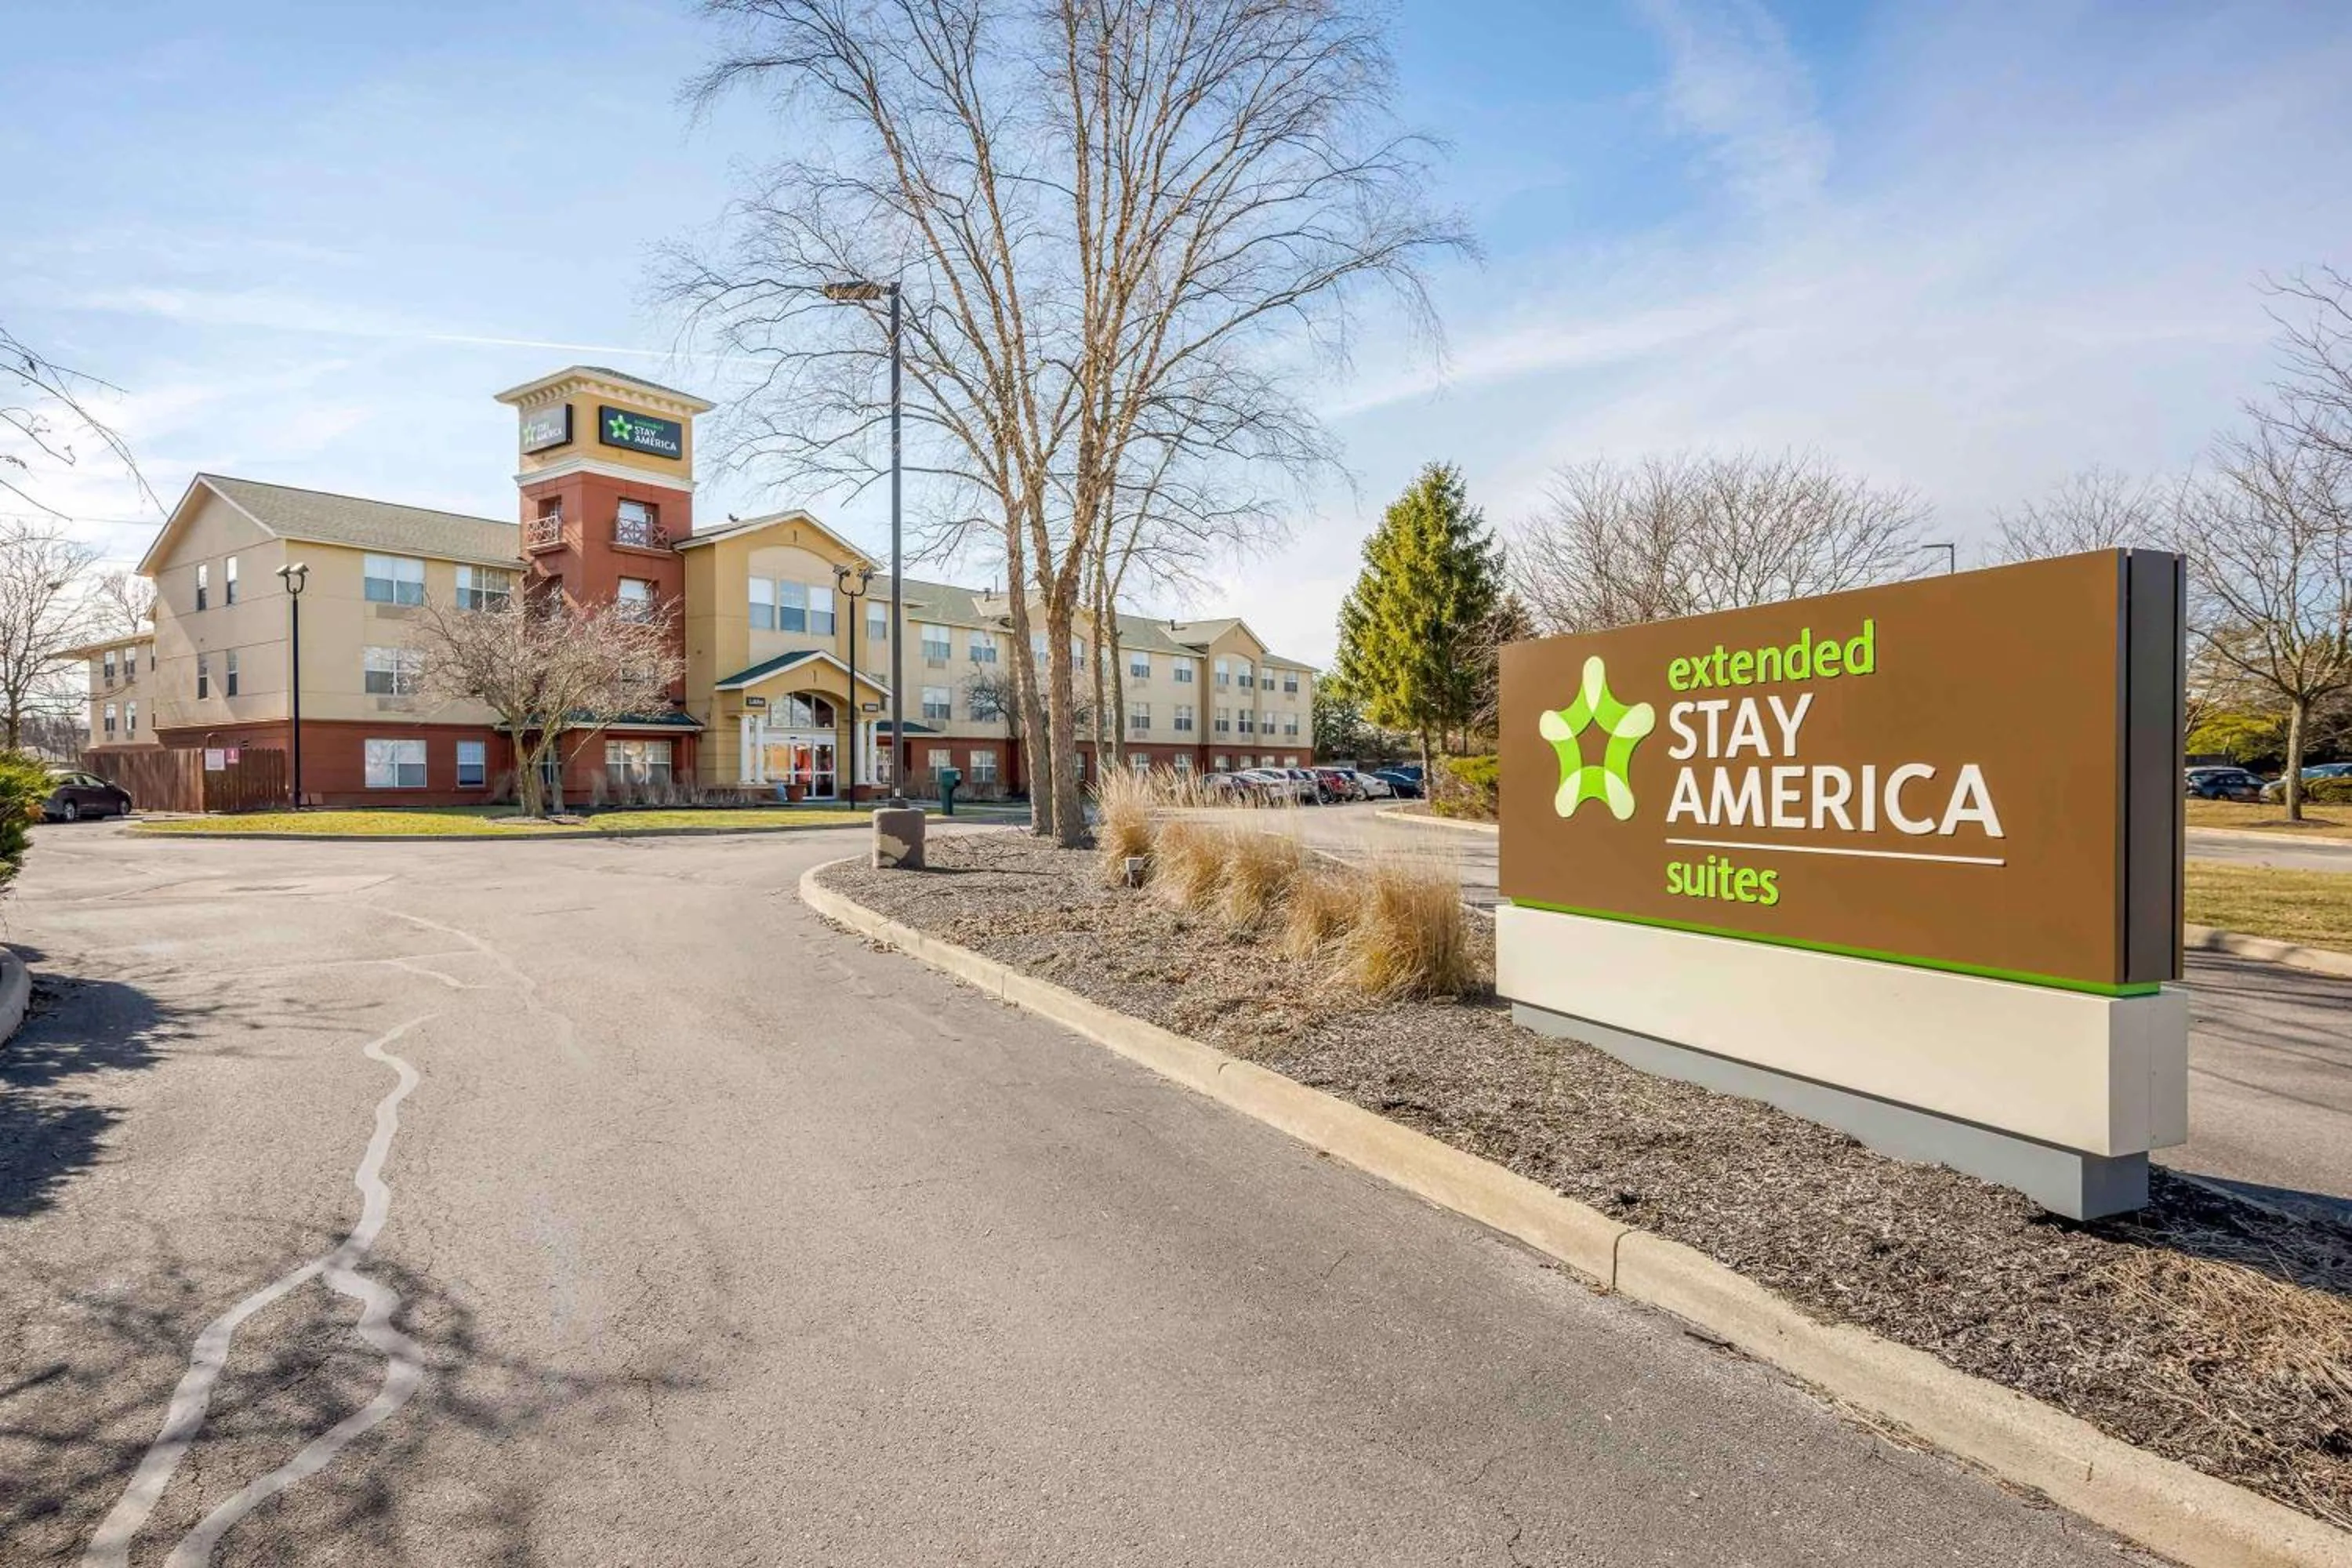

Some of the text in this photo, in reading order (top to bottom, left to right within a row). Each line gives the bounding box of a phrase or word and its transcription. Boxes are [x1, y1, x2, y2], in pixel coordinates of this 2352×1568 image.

[634, 426, 656, 437] STAY
[634, 435, 677, 451] AMERICA
[1668, 619, 1875, 691] extended
[1668, 692, 1814, 760] STAY
[1665, 763, 2005, 838] AMERICA
[1665, 855, 1780, 906] suites
